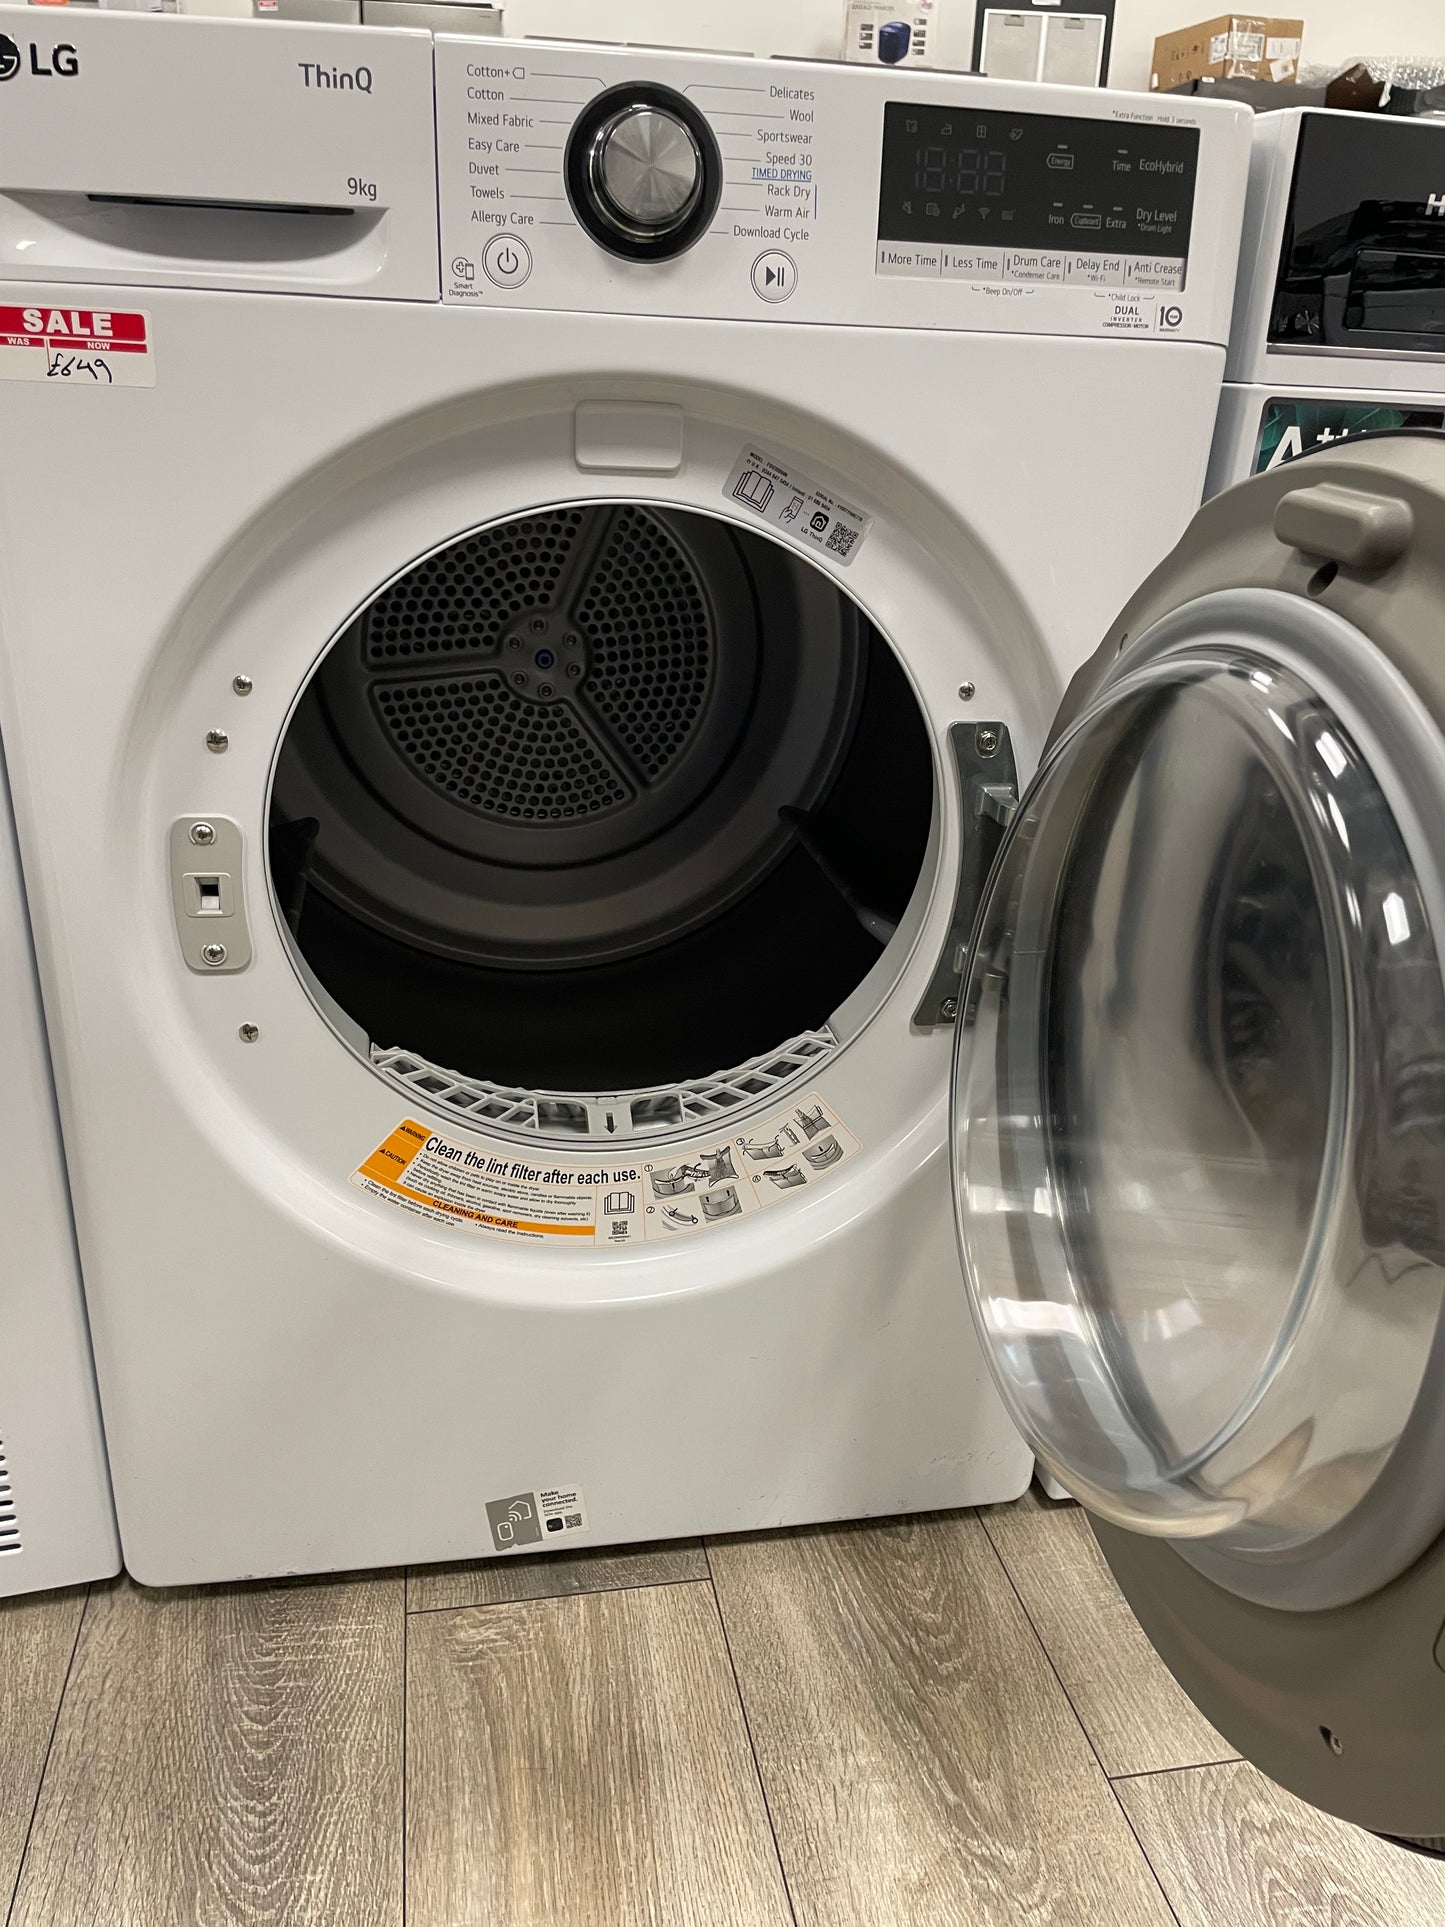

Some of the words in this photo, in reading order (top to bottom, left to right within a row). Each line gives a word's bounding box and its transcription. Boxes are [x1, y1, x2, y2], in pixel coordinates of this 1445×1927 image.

[30, 43, 79, 76] LG
[467, 64, 510, 78] Cotton+
[298, 63, 373, 94] ThinQ
[468, 87, 504, 100] Cotton
[770, 86, 815, 100] Delicates
[468, 112, 499, 126] Mixed
[502, 114, 534, 128] Fabric
[790, 109, 814, 123] Wool
[757, 128, 812, 144] Sportswear
[468, 138, 492, 154] Easy
[496, 140, 520, 152] Care
[766, 152, 796, 167] Speed
[799, 154, 812, 166] 30
[1050, 156, 1071, 168] Energy
[1112, 160, 1132, 172] Time
[1139, 158, 1184, 175] EcoHybrid
[469, 162, 499, 176] Duvet
[752, 167, 778, 178] TIMED
[780, 169, 812, 180] DRYING
[347, 178, 378, 201] 9kg
[470, 186, 504, 199] Towels
[768, 184, 790, 196] Rack
[794, 186, 811, 200] Dry
[471, 210, 508, 226] Allergy
[510, 212, 534, 224] Care
[765, 205, 792, 218] Warm
[795, 207, 810, 218] Air
[1136, 208, 1152, 221] Dry
[1154, 210, 1177, 222] Level
[1048, 214, 1064, 224] Iron
[1106, 217, 1126, 228] Extra
[734, 224, 781, 239] Download
[784, 228, 810, 242] Cycle
[1157, 224, 1172, 234] Light
[888, 253, 912, 264] More
[916, 254, 937, 266] Time
[952, 256, 973, 268] Less
[976, 258, 998, 270] Time
[1014, 255, 1038, 267] Drum
[1040, 256, 1061, 268] Care
[1076, 258, 1100, 272] Delay
[1103, 260, 1120, 272] End
[1134, 262, 1152, 273] Anti
[1154, 263, 1183, 275] Crease
[1046, 272, 1060, 280] Care
[1160, 278, 1175, 286] Start
[454, 282, 473, 290] Smart
[1002, 288, 1023, 296] On/Off
[1114, 306, 1140, 316] DUAL
[1160, 306, 1183, 327] 10
[22, 309, 114, 337] SALE
[8, 337, 30, 346] WAS
[88, 342, 110, 350] NOW
[46, 352, 112, 384] £649
[810, 531, 824, 542] ThinQ
[385, 1150, 406, 1166] CAUTION
[426, 1136, 463, 1164] Clean
[464, 1151, 486, 1169] the
[486, 1158, 508, 1176] lint
[510, 1163, 542, 1182] filter
[542, 1169, 574, 1184] after
[577, 1169, 610, 1184] each
[613, 1168, 641, 1183] use.
[432, 1200, 475, 1220] CLEANING
[474, 1214, 493, 1223] AND
[495, 1218, 518, 1228] CARE
